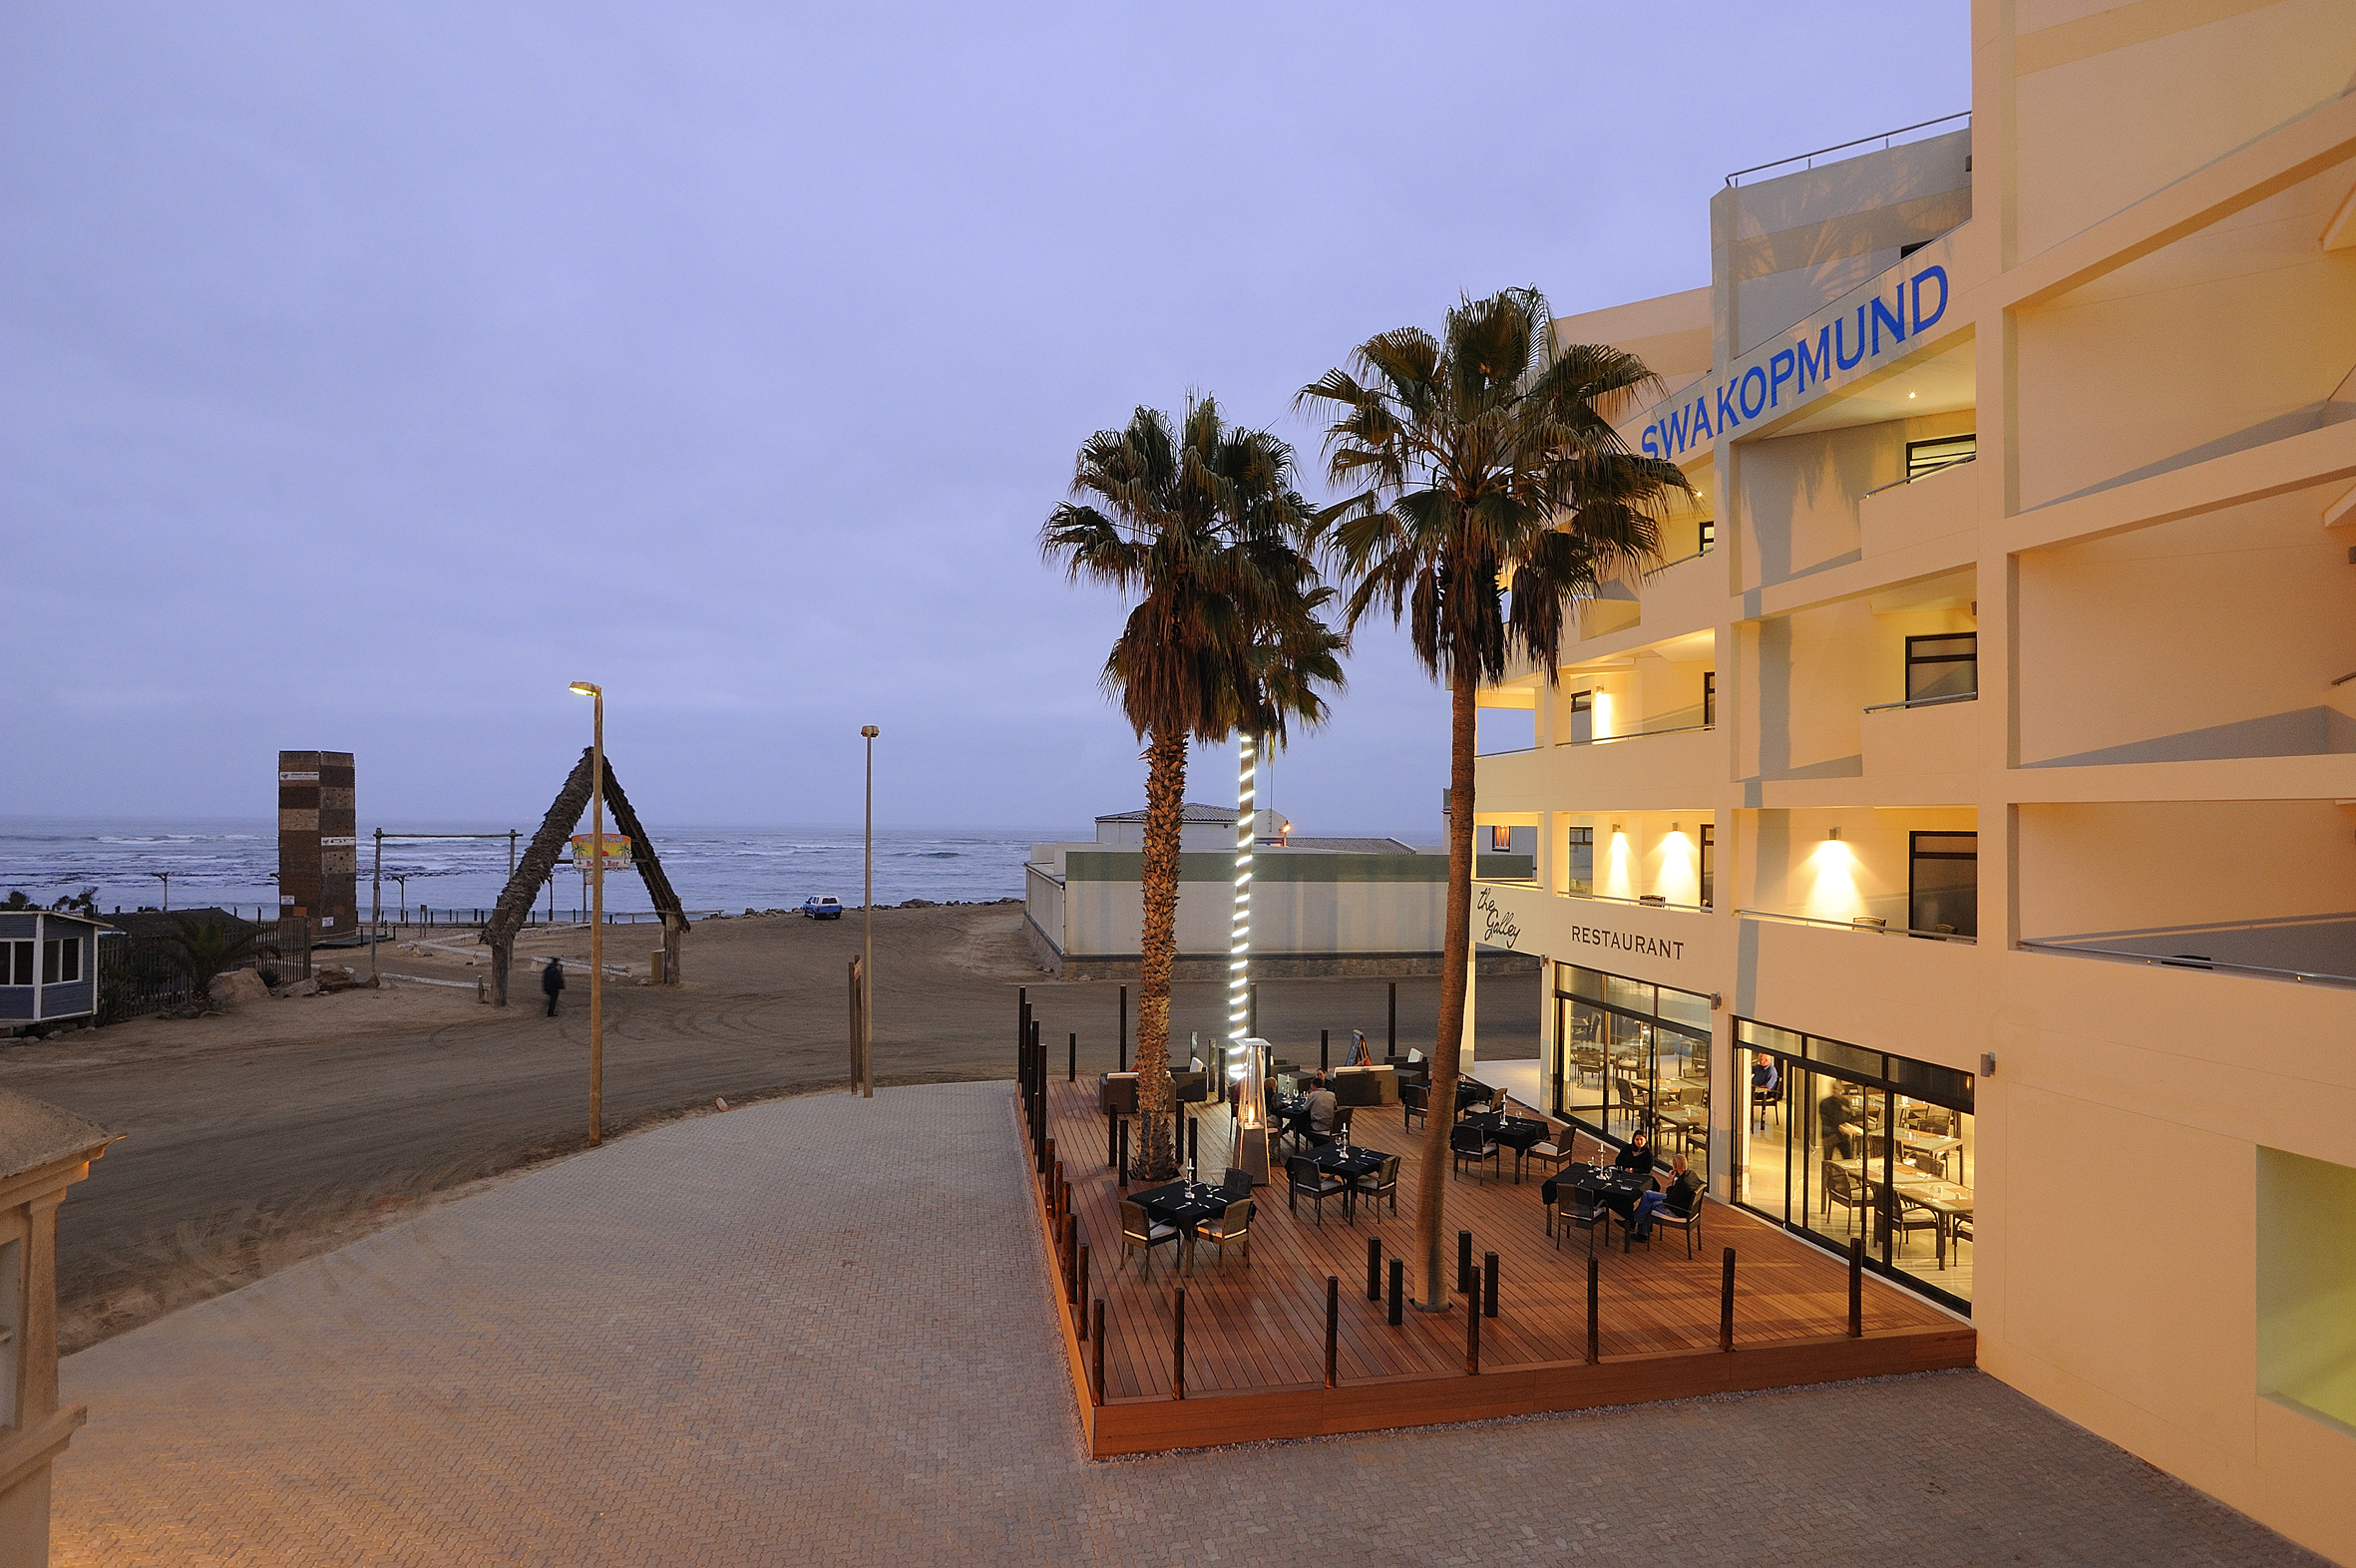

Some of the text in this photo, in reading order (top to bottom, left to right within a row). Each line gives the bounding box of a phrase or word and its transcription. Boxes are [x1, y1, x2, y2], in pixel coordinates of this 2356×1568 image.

[1641, 264, 1949, 460] SWAKOPMUND
[1476, 887, 1496, 912] the
[1484, 908, 1521, 950] Galley
[1571, 925, 1685, 961] RESTAURANT
